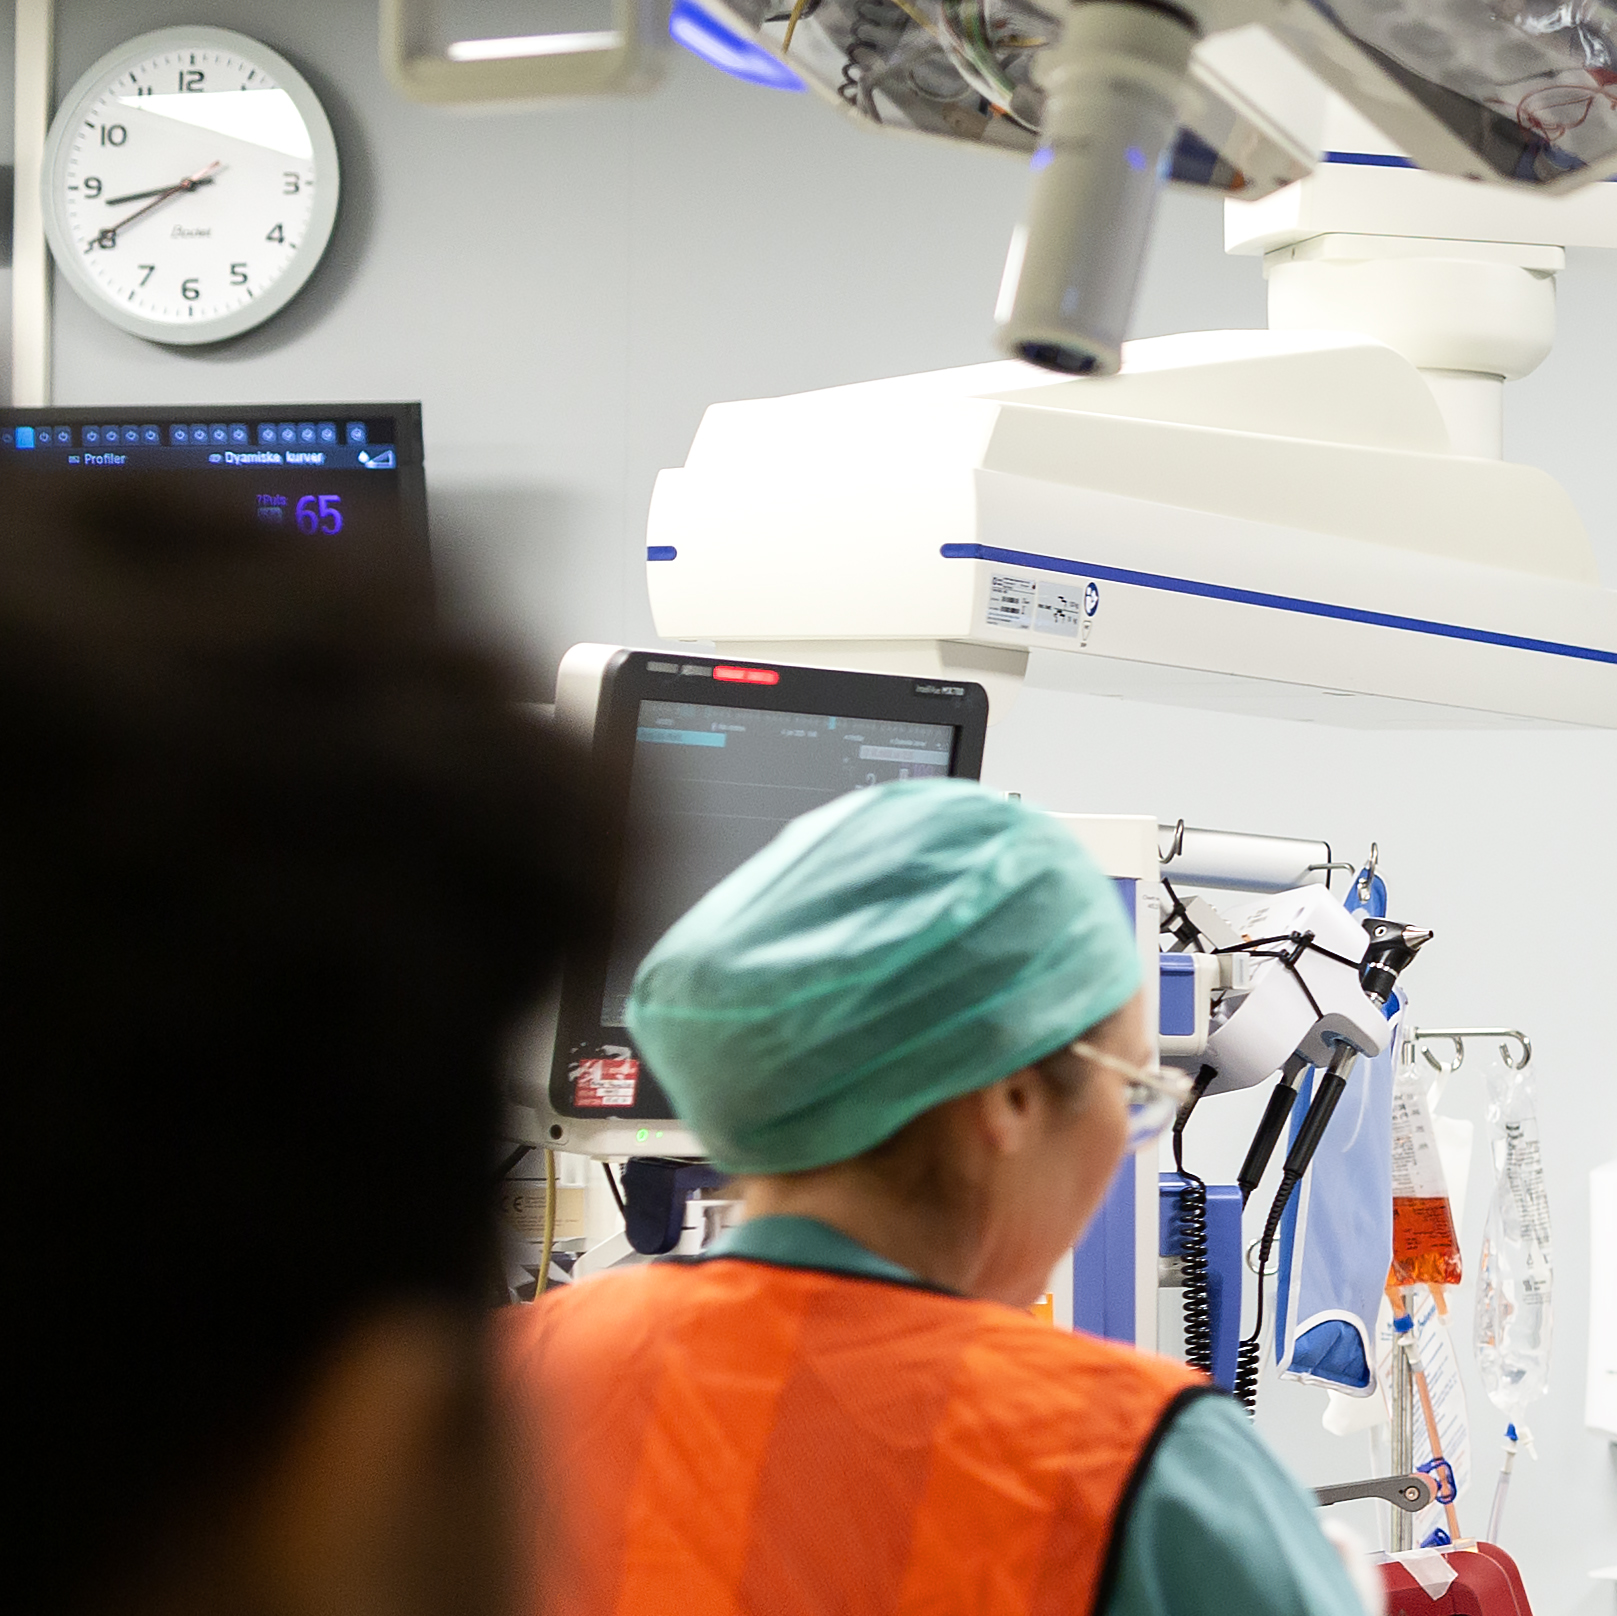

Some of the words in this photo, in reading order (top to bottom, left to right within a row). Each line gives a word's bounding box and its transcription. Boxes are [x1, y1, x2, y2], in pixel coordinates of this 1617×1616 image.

[178, 70, 205, 93] 12
[100, 124, 127, 147] 10
[84, 177, 102, 198] 9
[283, 172, 300, 194] 3
[266, 223, 285, 244] 4
[138, 265, 155, 286] 7
[230, 263, 248, 285] 5
[182, 279, 199, 300] 6
[84, 453, 126, 466] Profiler
[295, 494, 343, 535] 65
